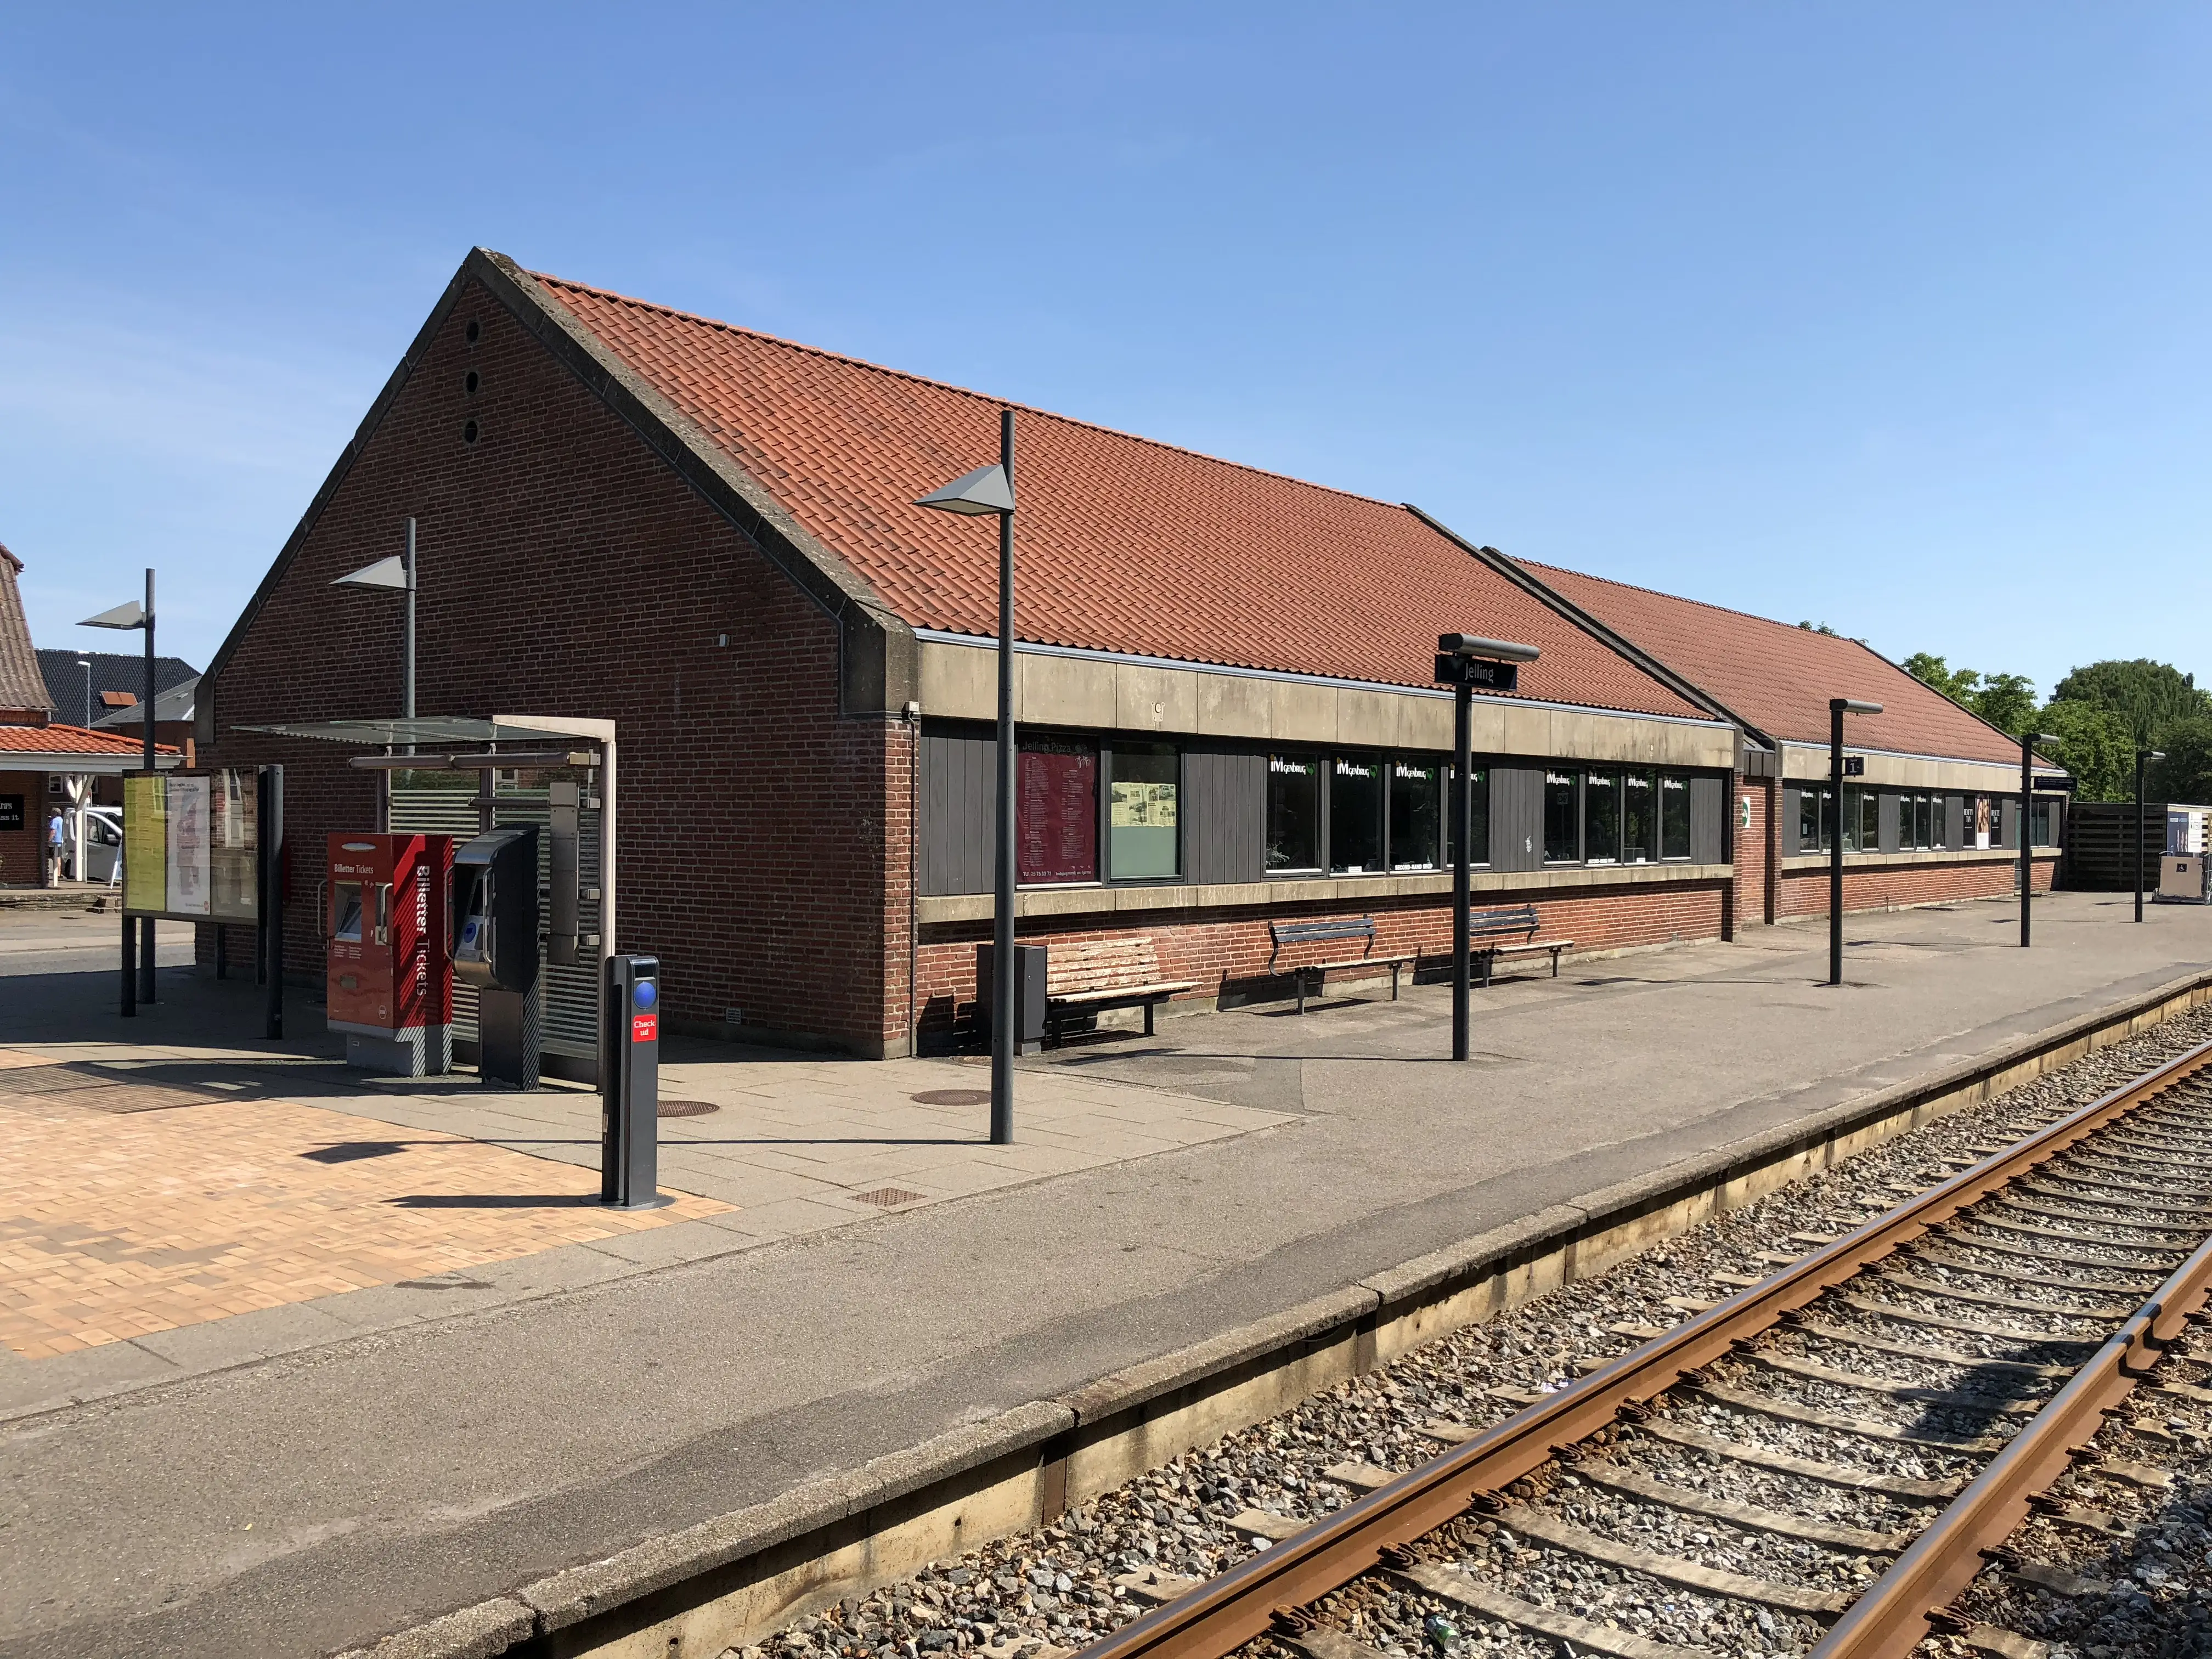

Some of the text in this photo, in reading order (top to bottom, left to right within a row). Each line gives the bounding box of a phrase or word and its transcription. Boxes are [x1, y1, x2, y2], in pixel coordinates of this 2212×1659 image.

[1465, 662, 1494, 684] Jelling
[1023, 741, 1071, 753] Jelling Pizza
[1850, 763, 1857, 772] 1
[334, 864, 373, 874] Billetter Tickets
[417, 866, 430, 996] Billetter Tickets
[634, 1020, 655, 1028] Check
